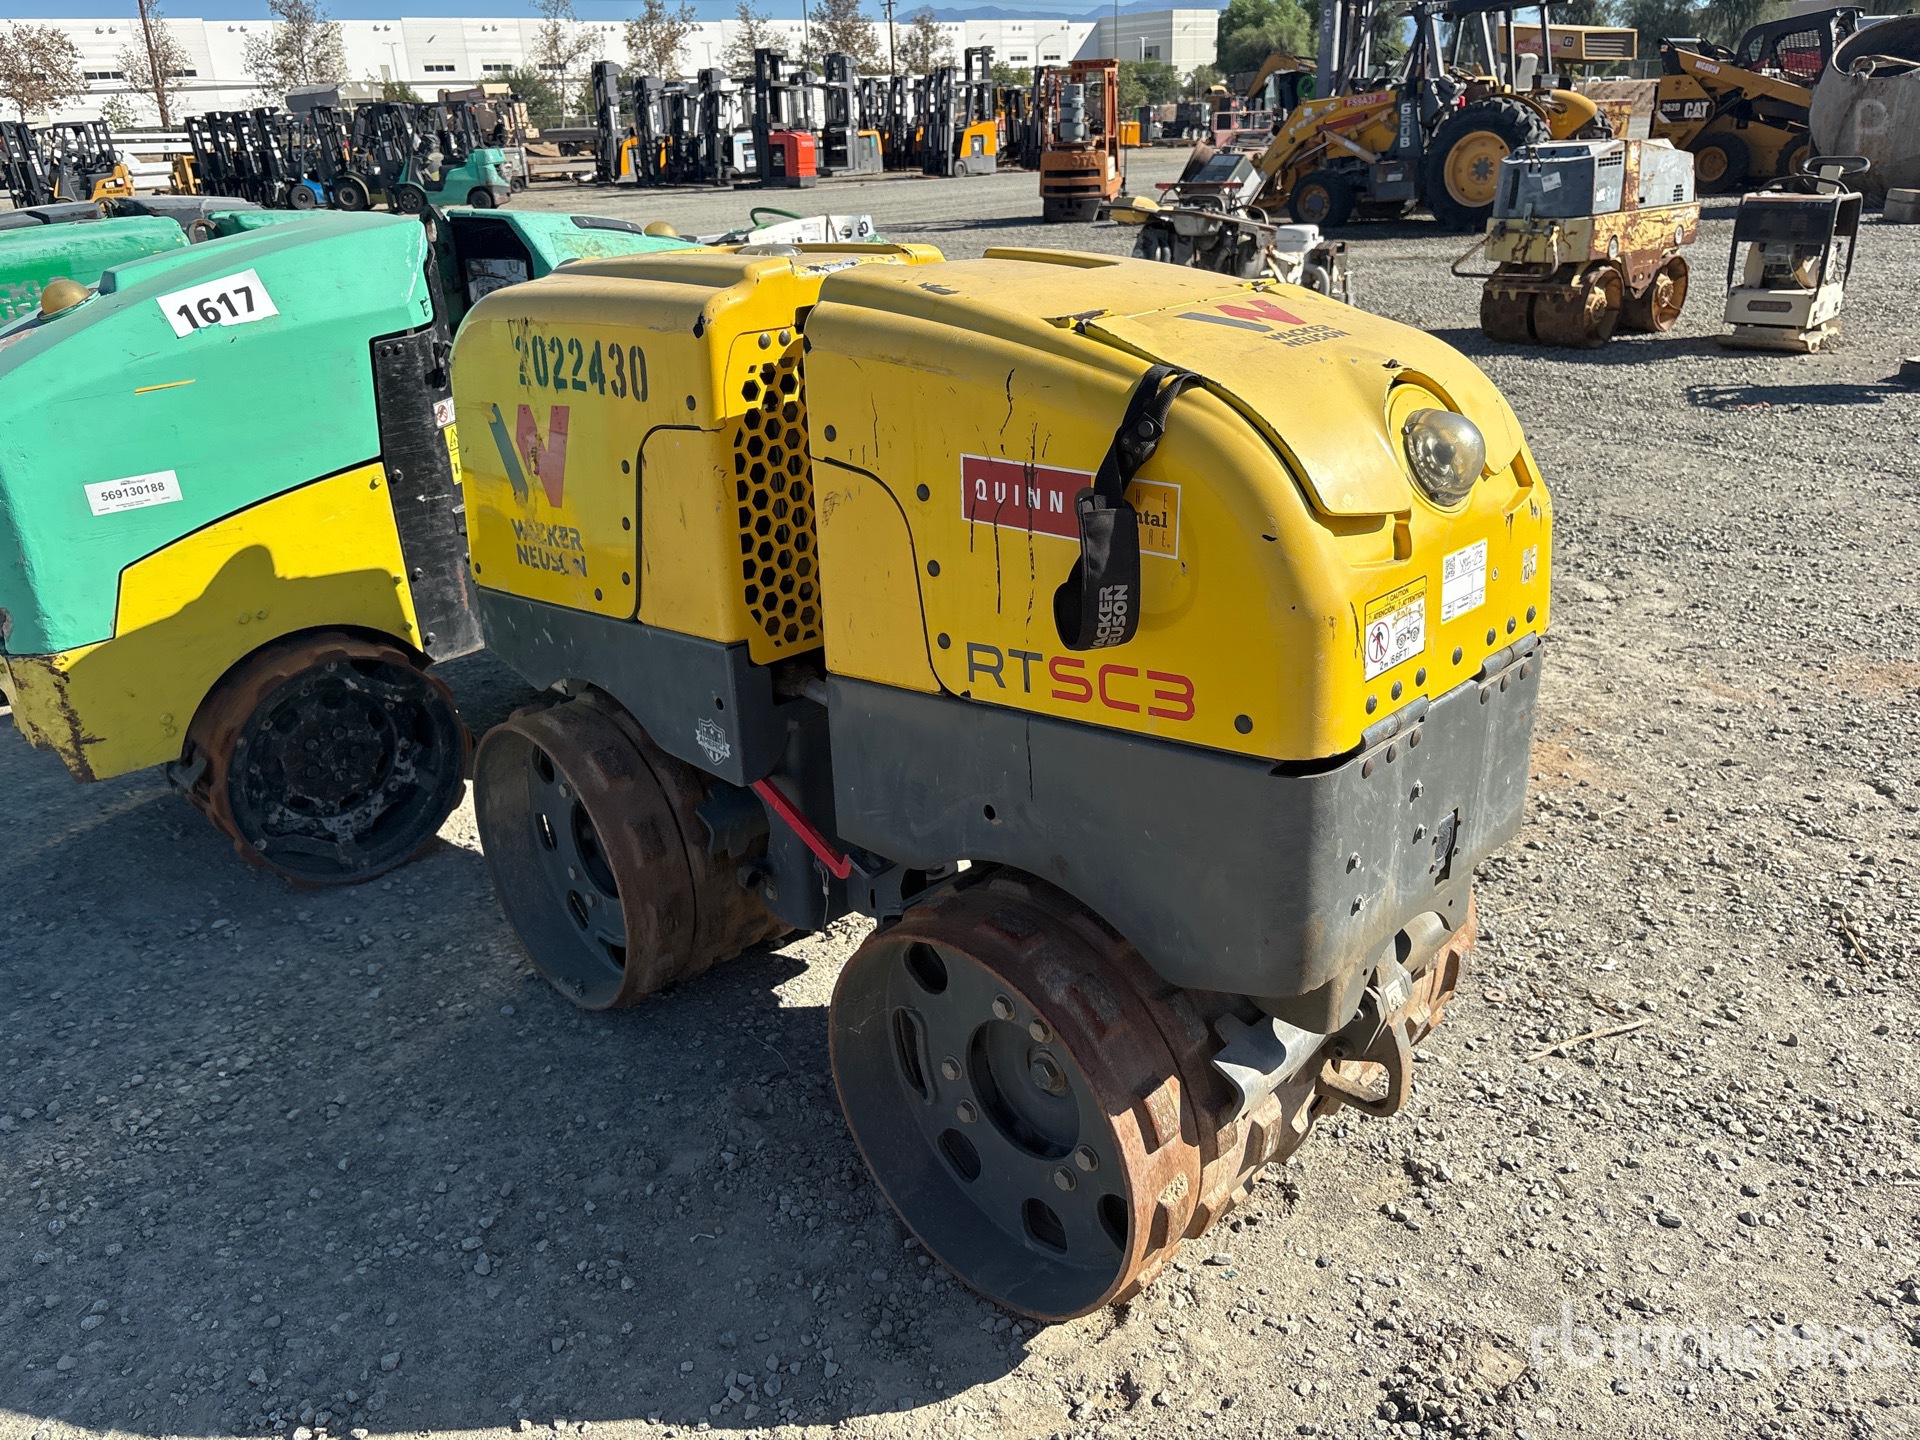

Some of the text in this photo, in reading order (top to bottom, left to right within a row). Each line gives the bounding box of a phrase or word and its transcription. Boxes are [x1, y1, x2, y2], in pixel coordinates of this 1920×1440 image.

[1683, 101, 1710, 119] CAT
[1400, 102, 1412, 149] 650B
[176, 285, 255, 330] 1617
[1263, 324, 1335, 341] WACKER
[1281, 329, 1352, 348] NEUSON
[515, 335, 649, 403] 2022430
[101, 482, 166, 502] 569130188
[975, 478, 1064, 514] QUINN
[1136, 510, 1168, 529] ntal
[1389, 587, 1410, 602] CAUTION
[1090, 585, 1114, 649] ACKER
[1104, 584, 1129, 647] EUSON
